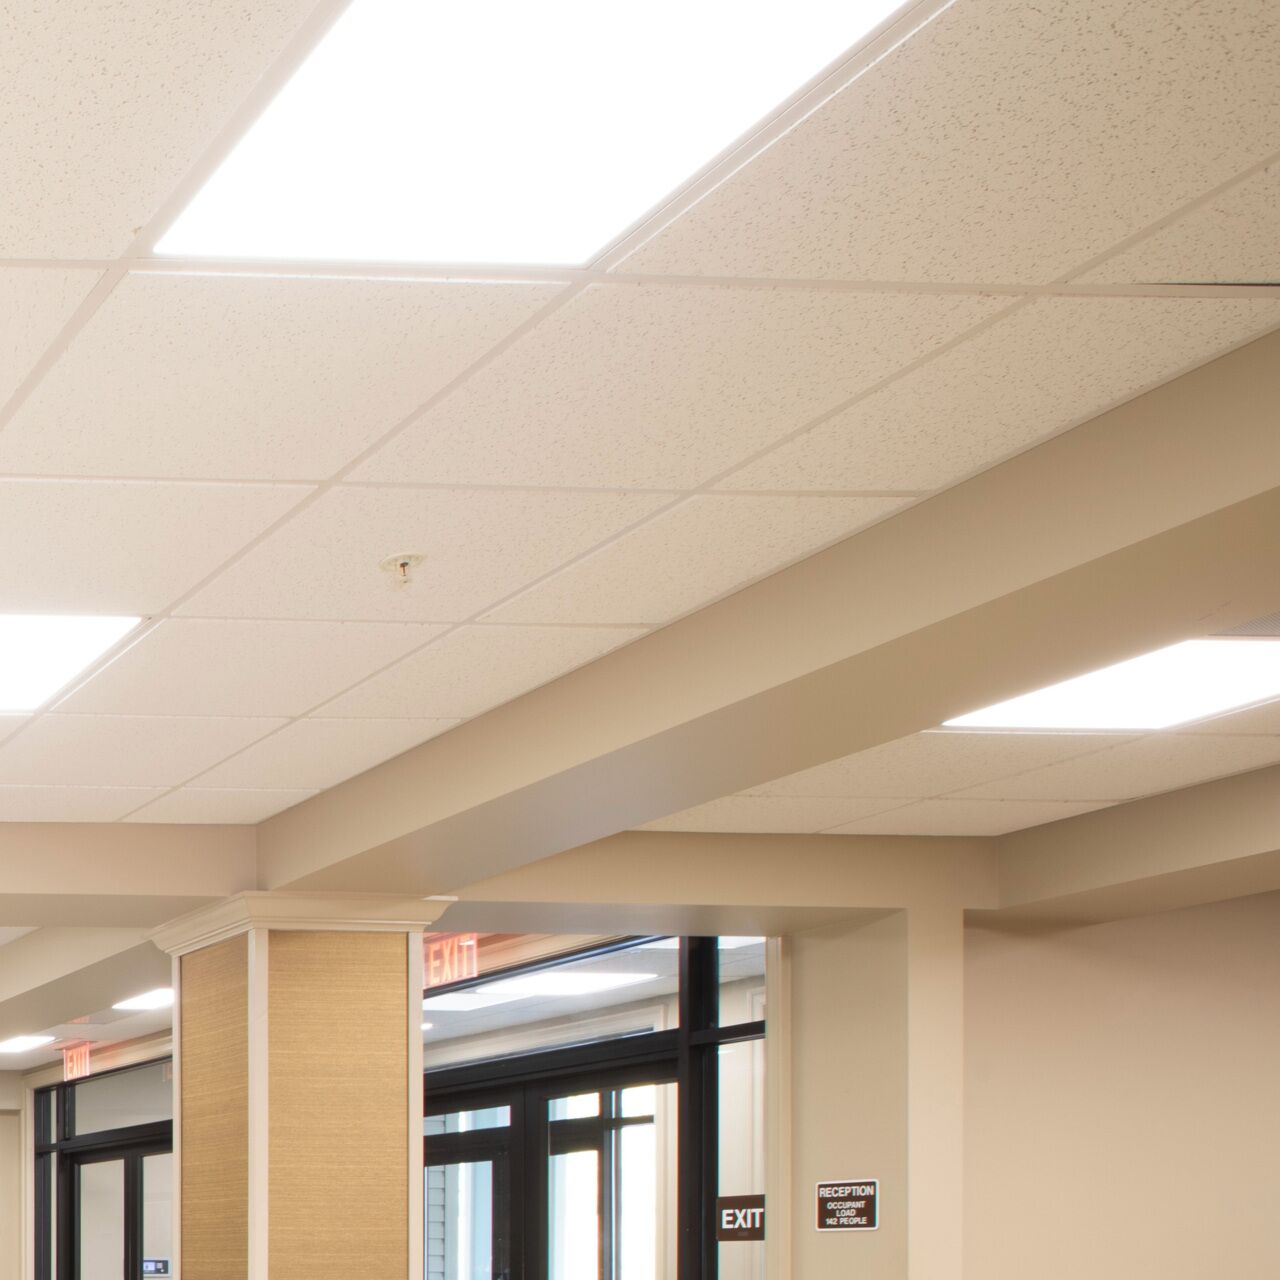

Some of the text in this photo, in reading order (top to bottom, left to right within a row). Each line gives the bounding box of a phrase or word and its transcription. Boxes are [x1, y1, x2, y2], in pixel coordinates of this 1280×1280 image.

[428, 938, 475, 984] EXIT
[819, 1185, 874, 1197] RECEPTION
[826, 1201, 866, 1209] OCCUPANT
[836, 1209, 856, 1217] LOAD
[721, 1208, 764, 1229] EXIT
[839, 1216, 868, 1225] PEOPLE
